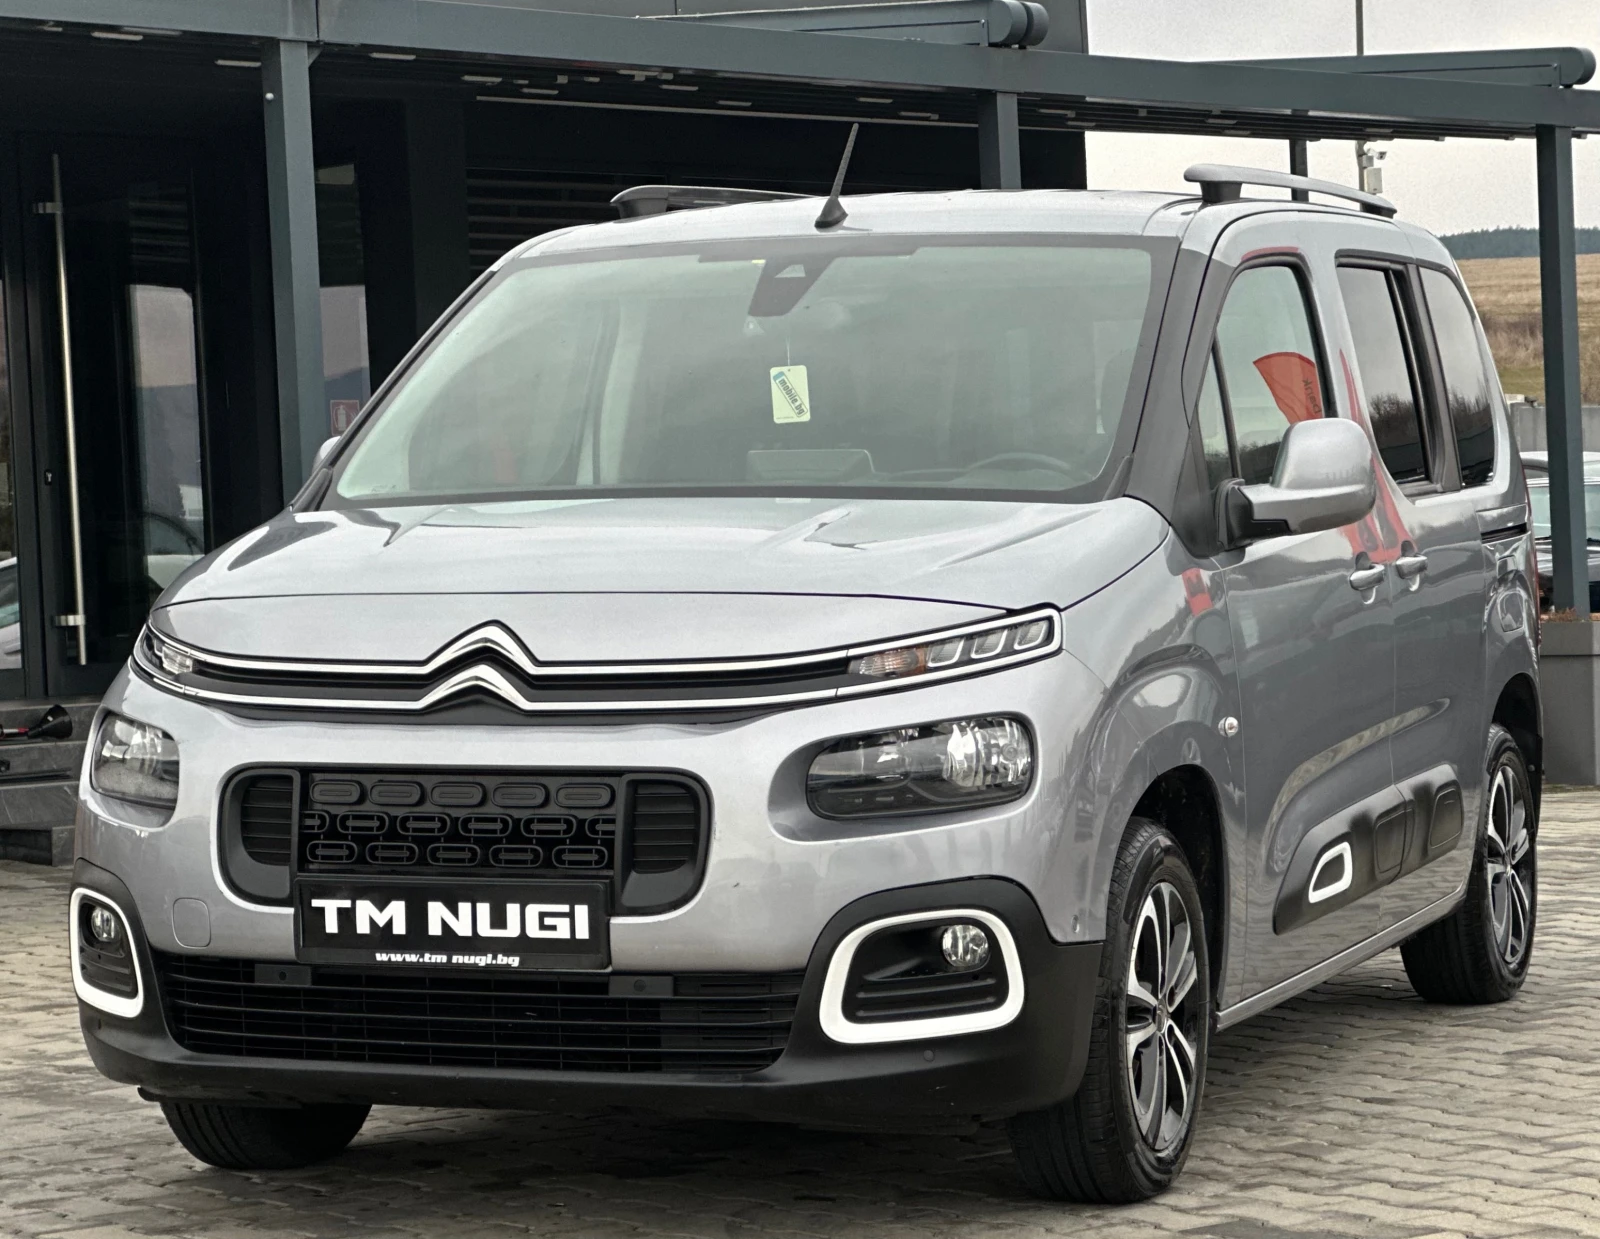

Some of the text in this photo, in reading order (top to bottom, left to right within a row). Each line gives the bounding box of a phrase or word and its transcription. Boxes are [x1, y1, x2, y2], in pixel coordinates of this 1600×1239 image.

[778, 377, 806, 416] mobile.bg
[311, 899, 590, 940] TM NUGI
[375, 952, 520, 968] www.tm nugi.bg
